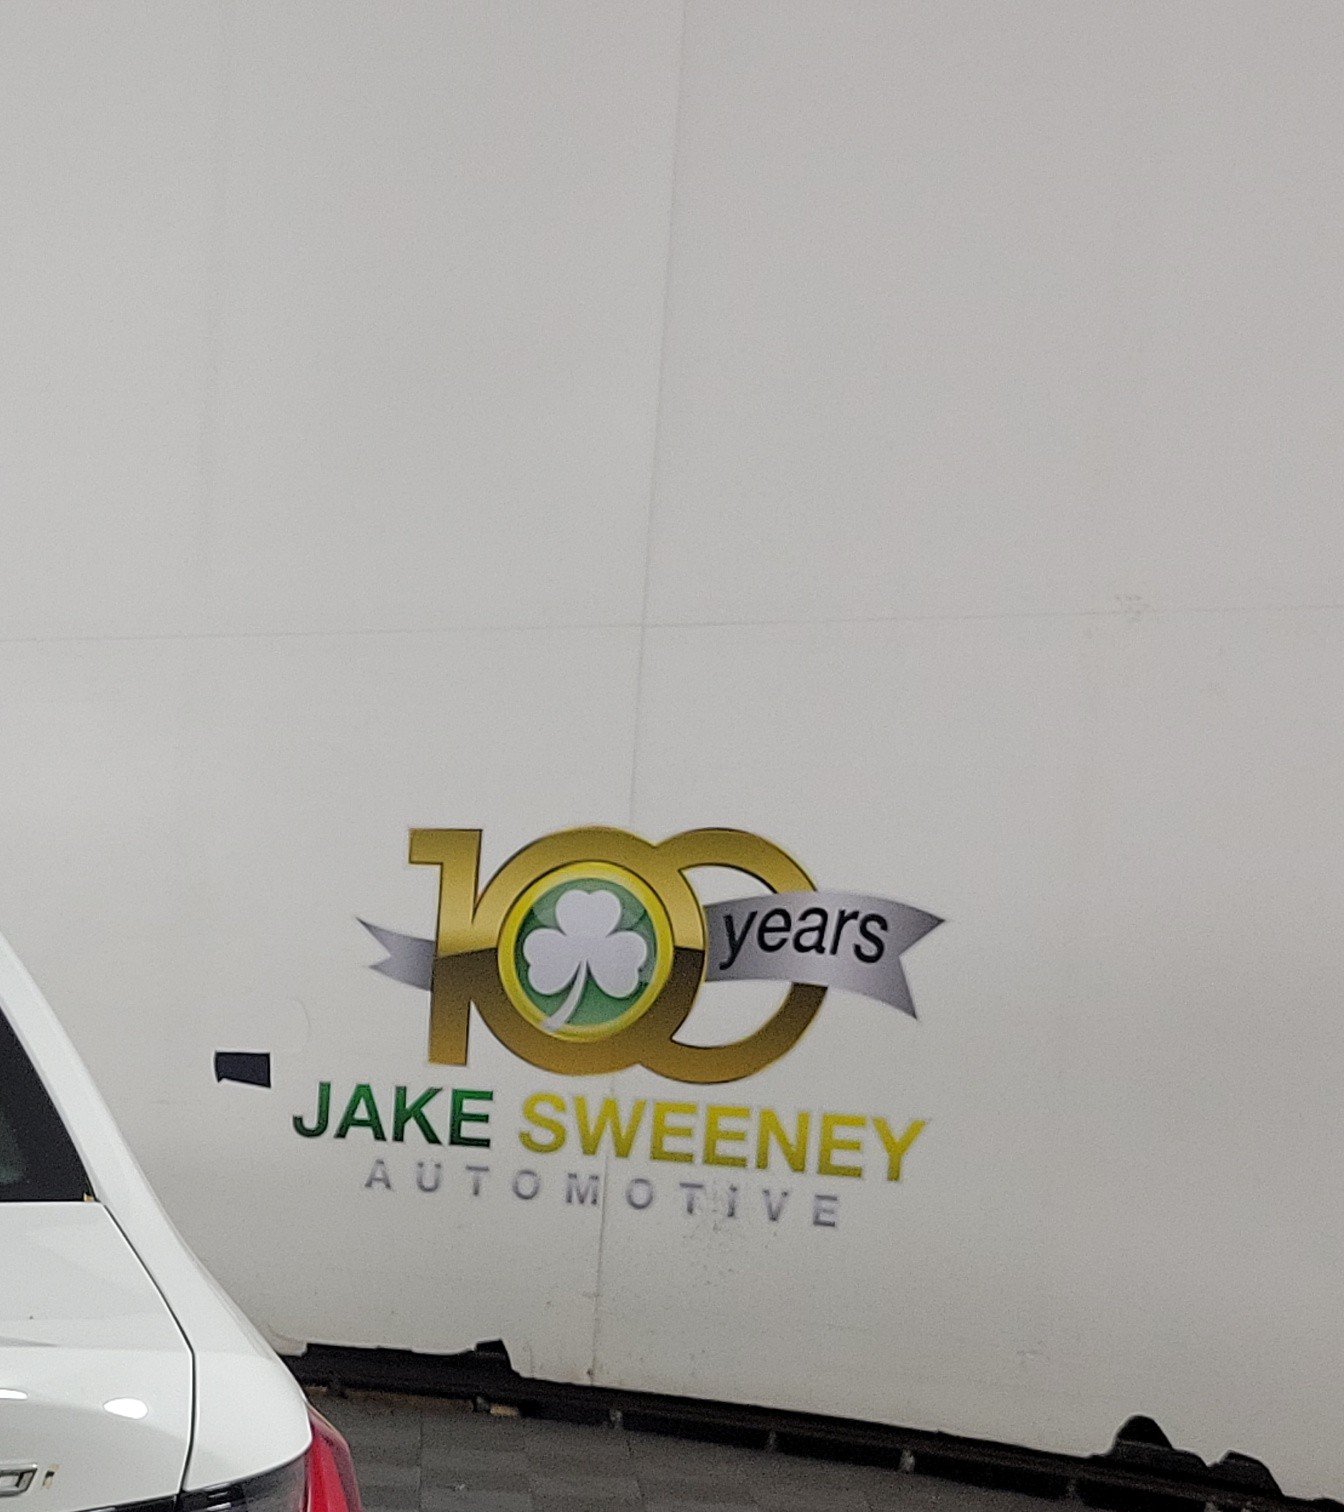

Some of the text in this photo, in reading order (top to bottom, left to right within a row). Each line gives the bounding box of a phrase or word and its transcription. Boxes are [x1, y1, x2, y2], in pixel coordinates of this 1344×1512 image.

[719, 901, 889, 970] years
[293, 1082, 925, 1182] JAKE SWEENEY
[365, 1159, 839, 1227] AUTOMOTIVE
